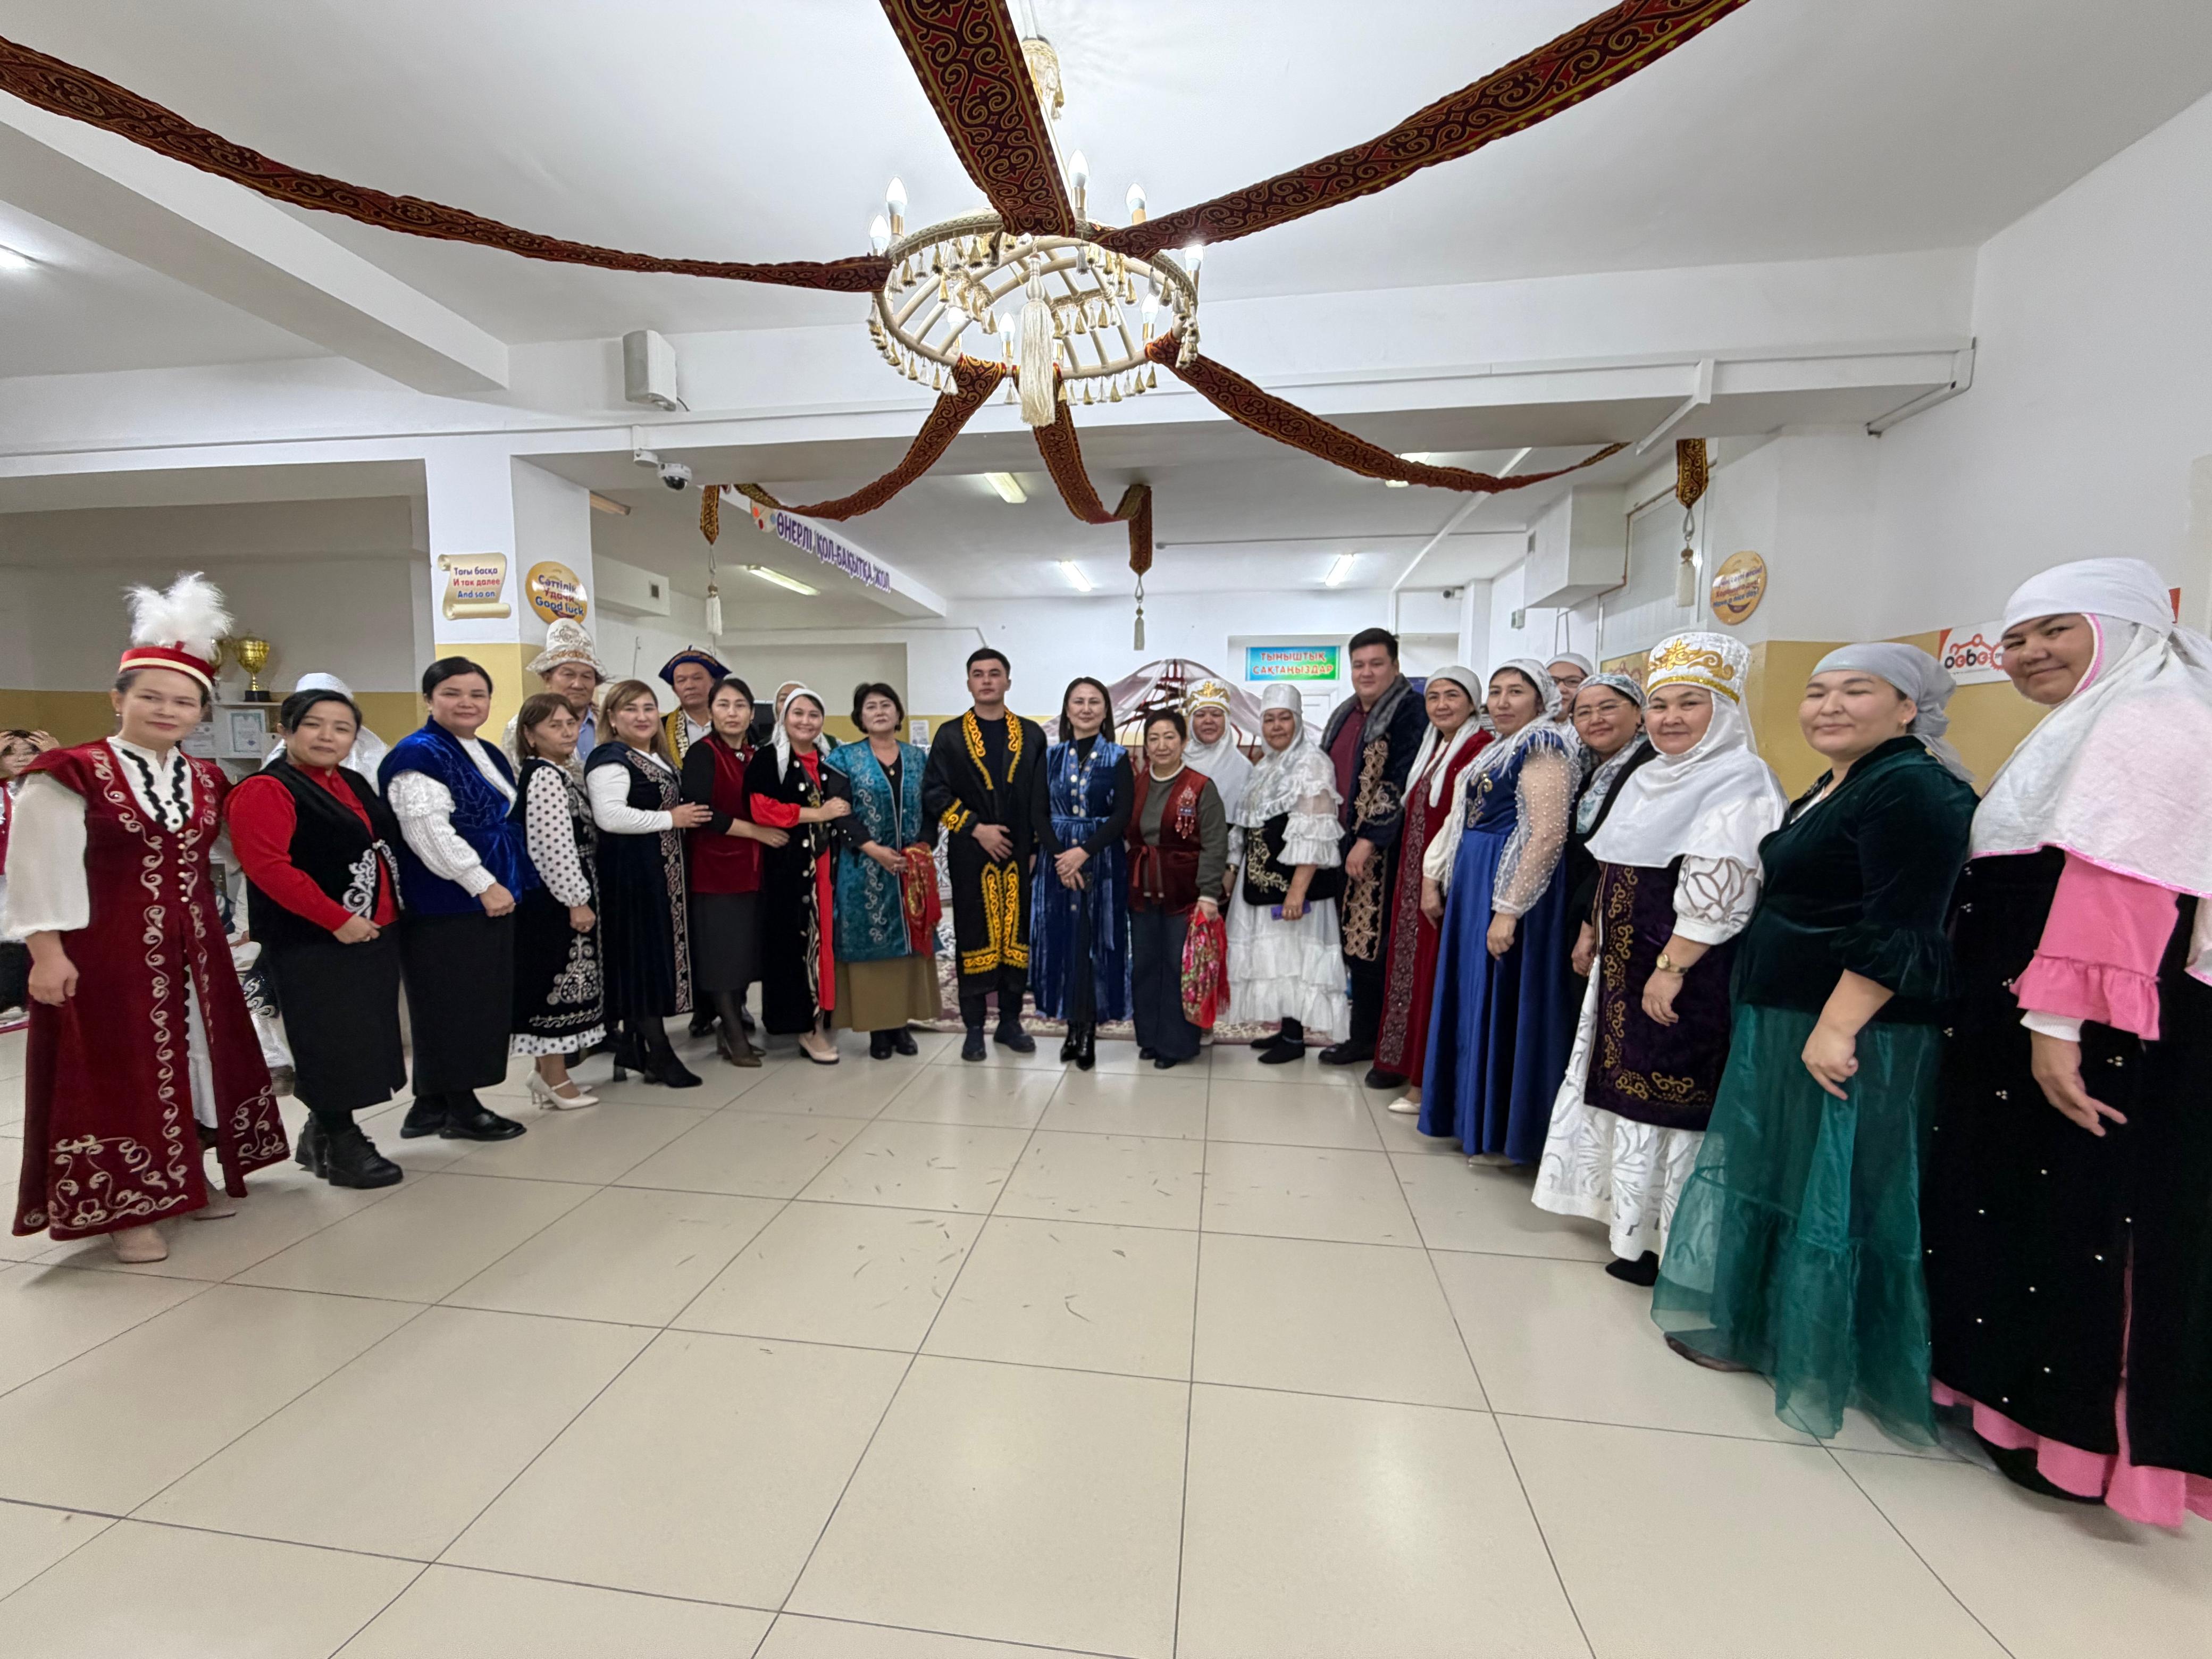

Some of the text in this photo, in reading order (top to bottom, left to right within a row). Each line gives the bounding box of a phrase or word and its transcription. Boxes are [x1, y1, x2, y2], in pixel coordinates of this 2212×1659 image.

[777, 512, 812, 551] ӨНЕРЛІ
[474, 566, 498, 576] басқа
[538, 574, 576, 593] Сәттілік
[535, 596, 584, 616] Good luck
[1261, 651, 1326, 662] ТЫНЫШТЫҚ
[1252, 664, 1334, 675] САҚТАҢЫЗДАР
